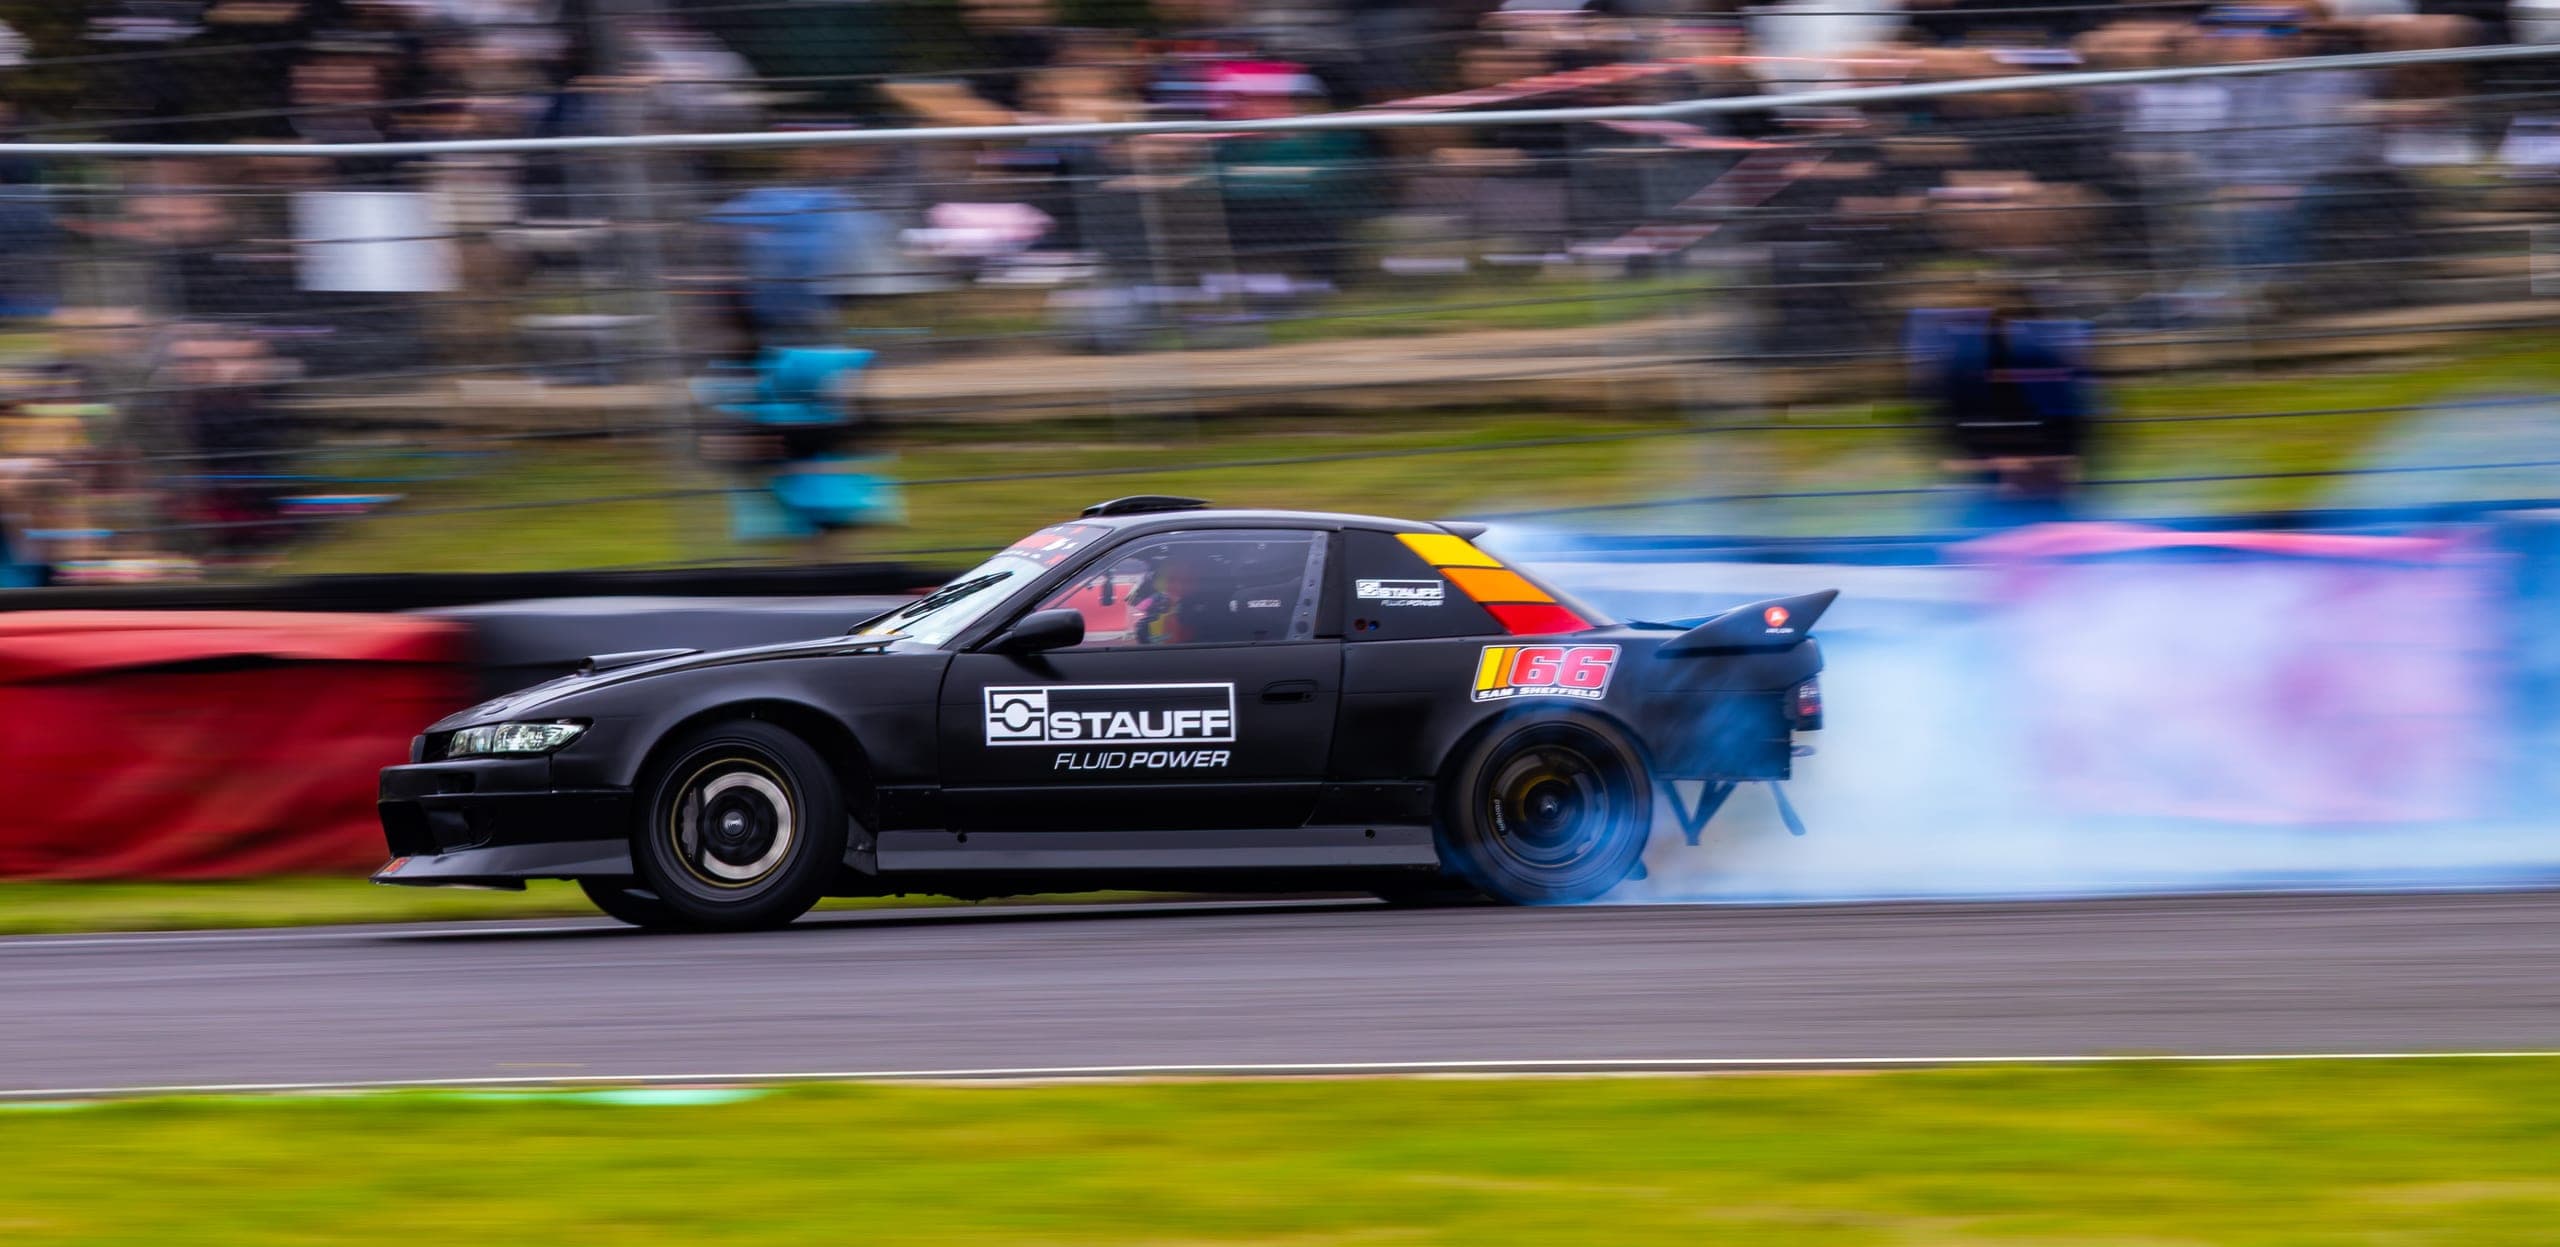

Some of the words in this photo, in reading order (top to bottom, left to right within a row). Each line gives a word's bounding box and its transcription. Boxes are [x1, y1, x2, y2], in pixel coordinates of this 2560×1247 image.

[1508, 647, 1616, 689] 66
[1478, 688, 1514, 699] SAM
[1519, 687, 1600, 698] SHEFFIELD
[1050, 710, 1230, 739] STAUFF
[1054, 752, 1126, 770] FLUID
[1129, 751, 1231, 769] POWER
